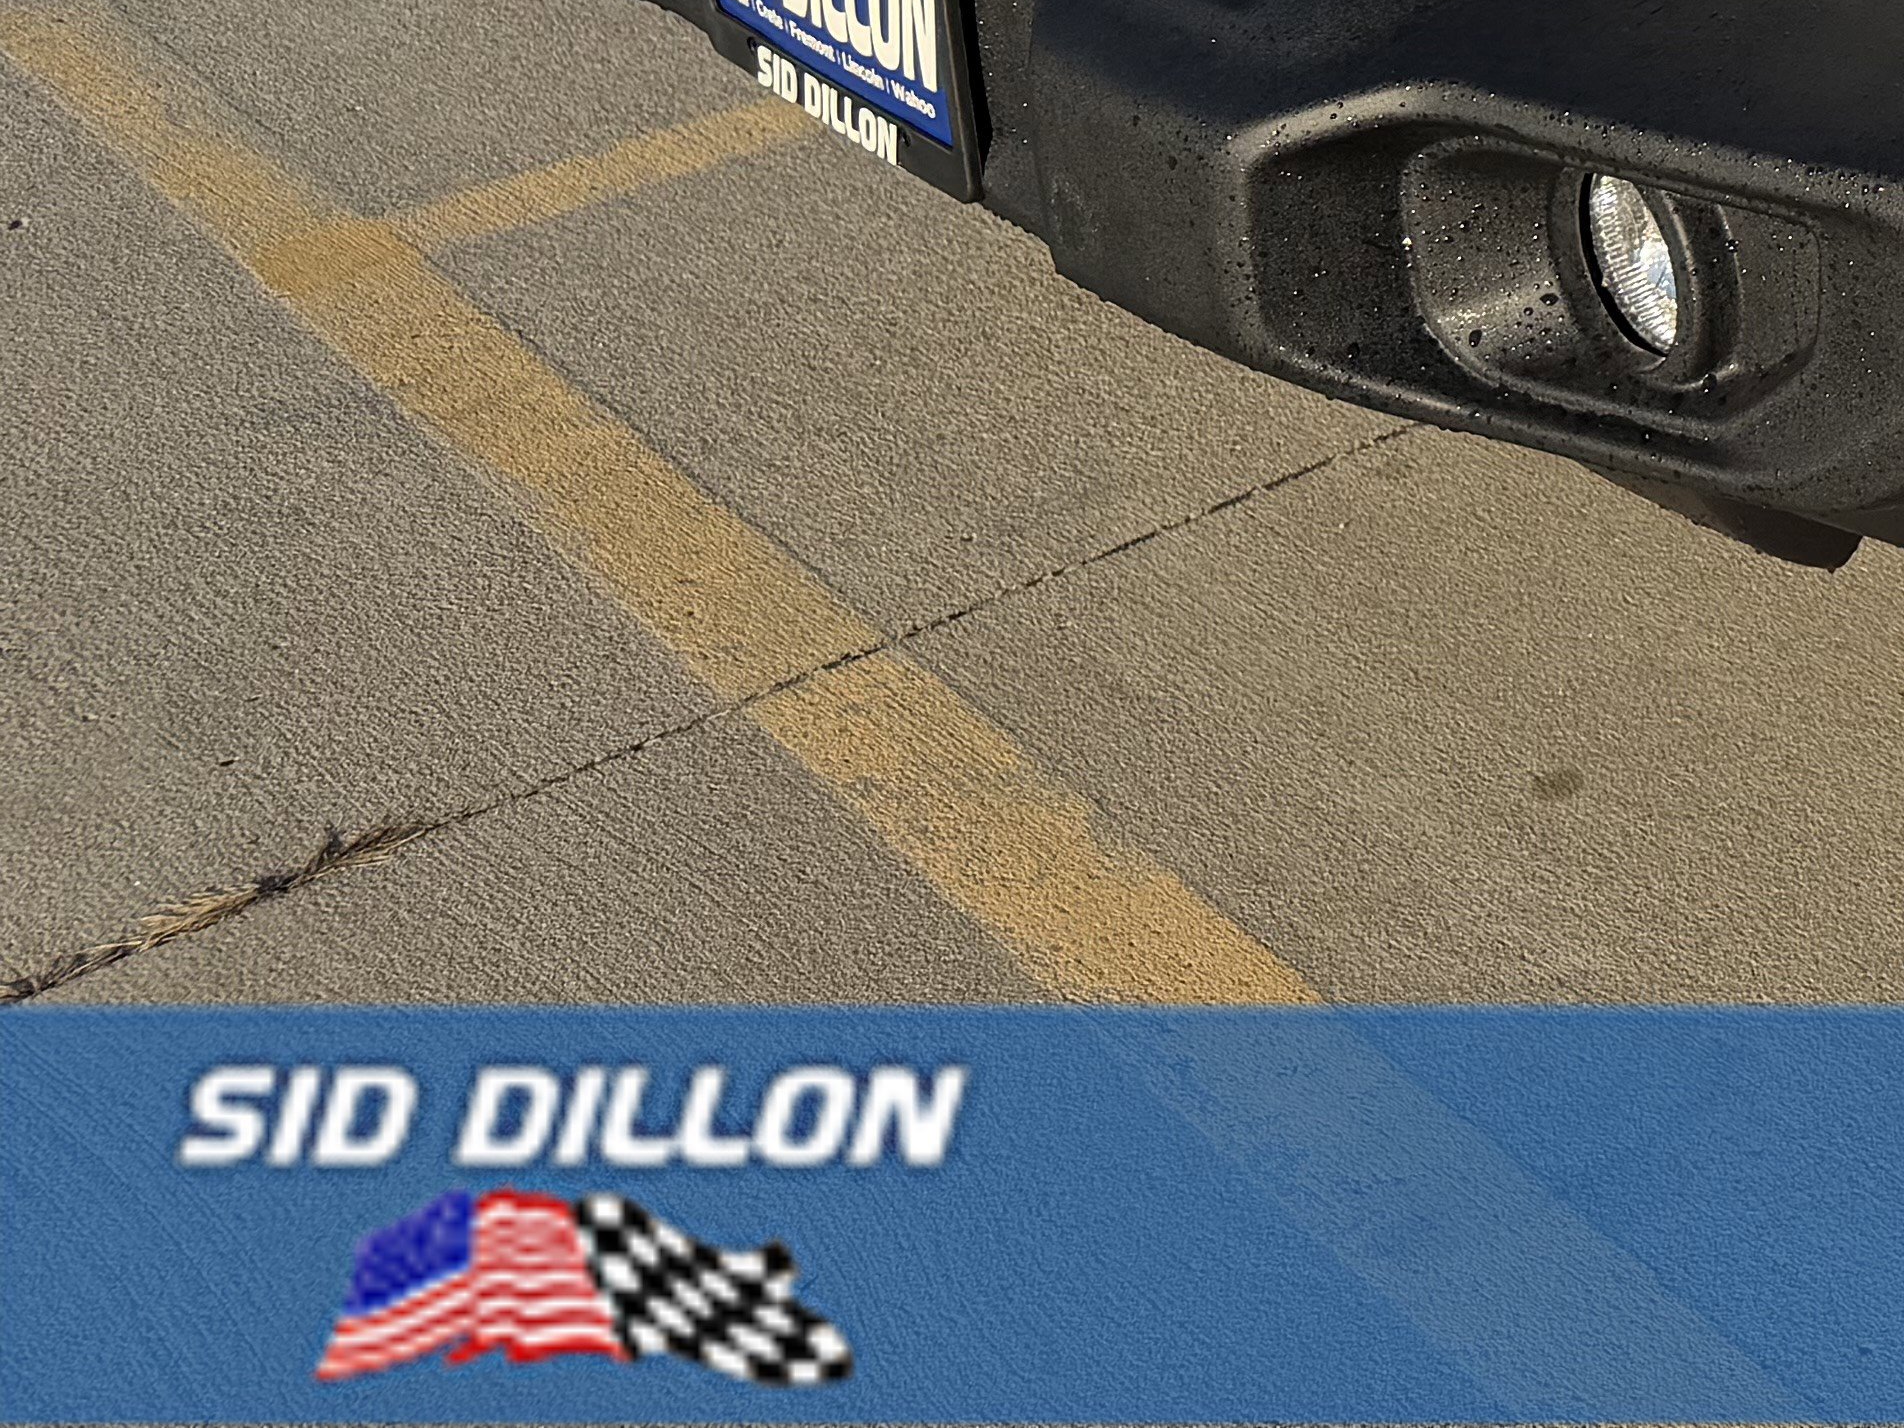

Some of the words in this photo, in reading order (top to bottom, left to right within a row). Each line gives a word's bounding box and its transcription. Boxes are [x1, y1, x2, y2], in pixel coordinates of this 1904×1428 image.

[756, 44, 799, 104] SID
[803, 71, 899, 167] DILLON
[890, 79, 937, 119] Wahoo
